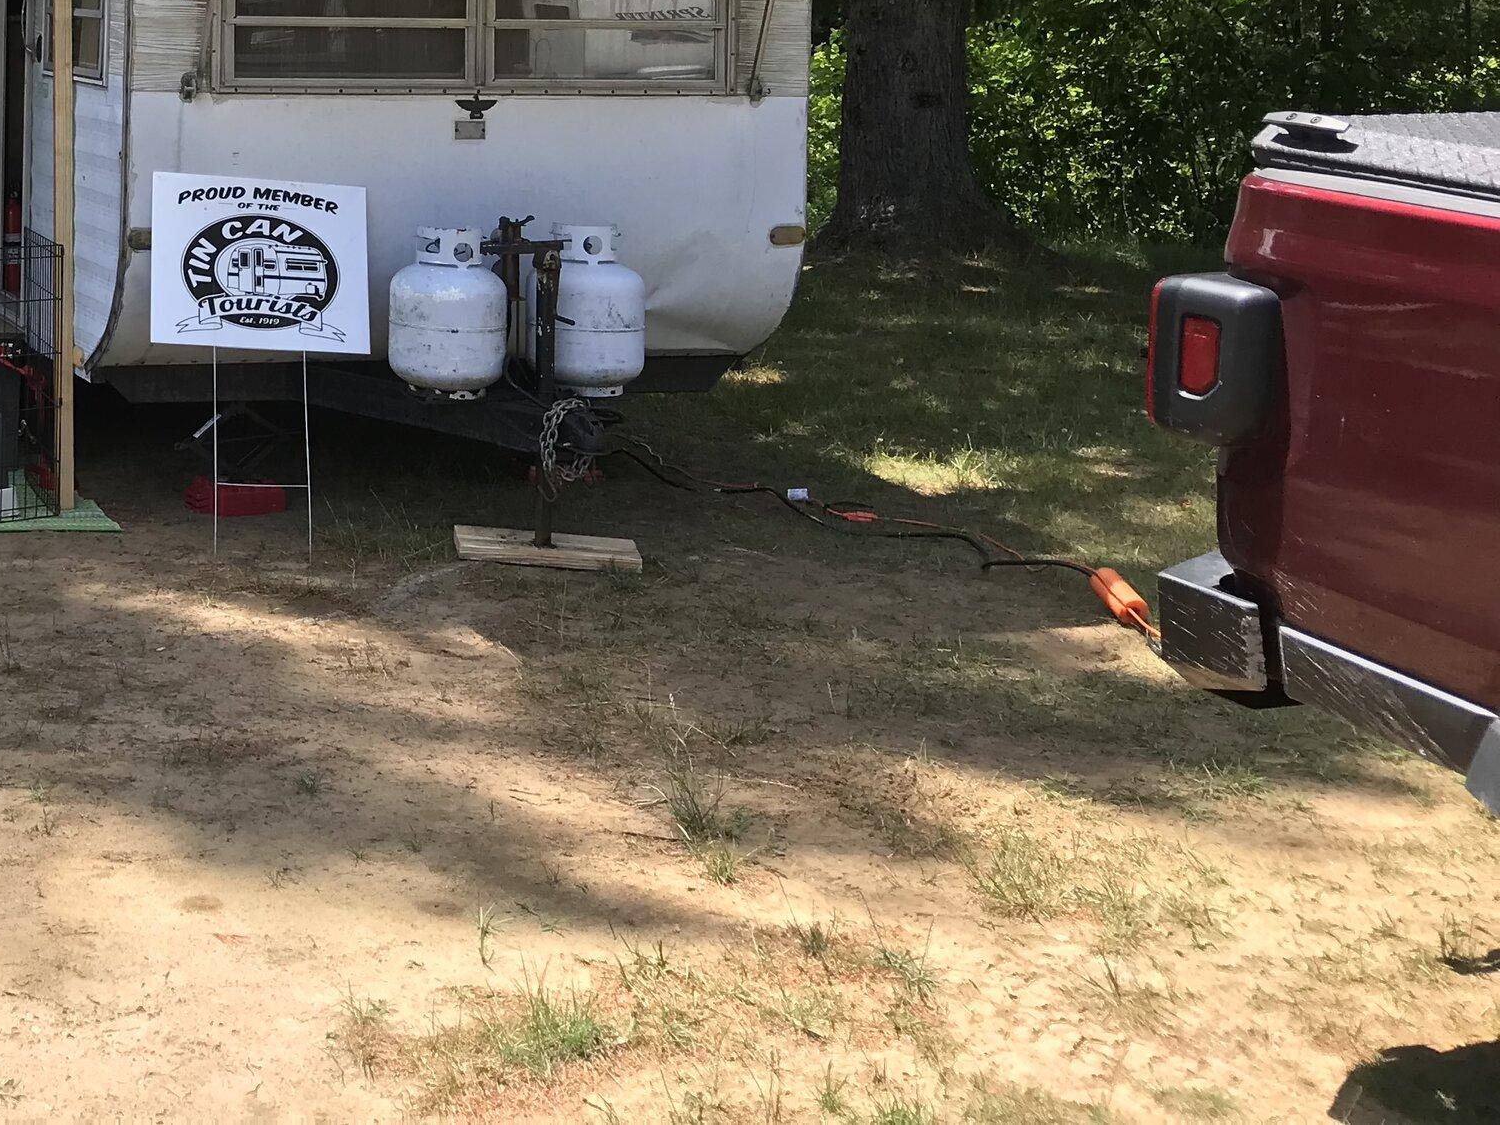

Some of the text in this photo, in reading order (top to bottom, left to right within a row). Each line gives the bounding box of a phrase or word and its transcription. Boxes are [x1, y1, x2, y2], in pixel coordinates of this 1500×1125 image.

[178, 186, 339, 215] PROUD MEMBER
[237, 202, 281, 212] OF THE
[187, 218, 304, 288] TIN CAN
[197, 293, 318, 322] Tourists
[239, 316, 280, 326] Est. 1919
